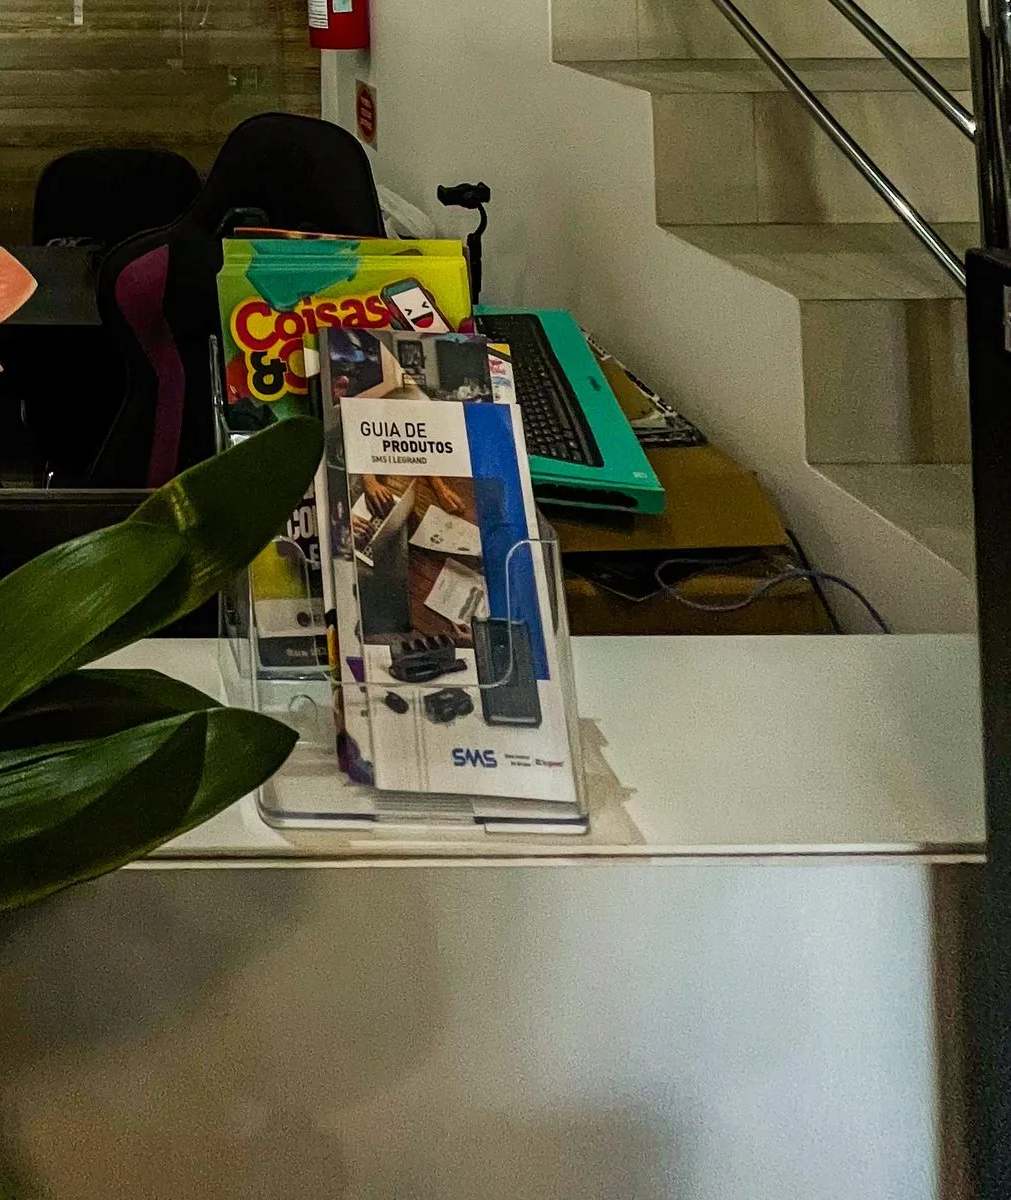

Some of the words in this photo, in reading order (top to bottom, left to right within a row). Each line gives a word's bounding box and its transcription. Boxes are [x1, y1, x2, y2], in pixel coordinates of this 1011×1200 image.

[236, 295, 391, 351] Coisas
[360, 421, 401, 438] GUIA
[405, 422, 428, 439] DE
[382, 440, 454, 454] PRODUTOS
[451, 747, 498, 769] SMS
